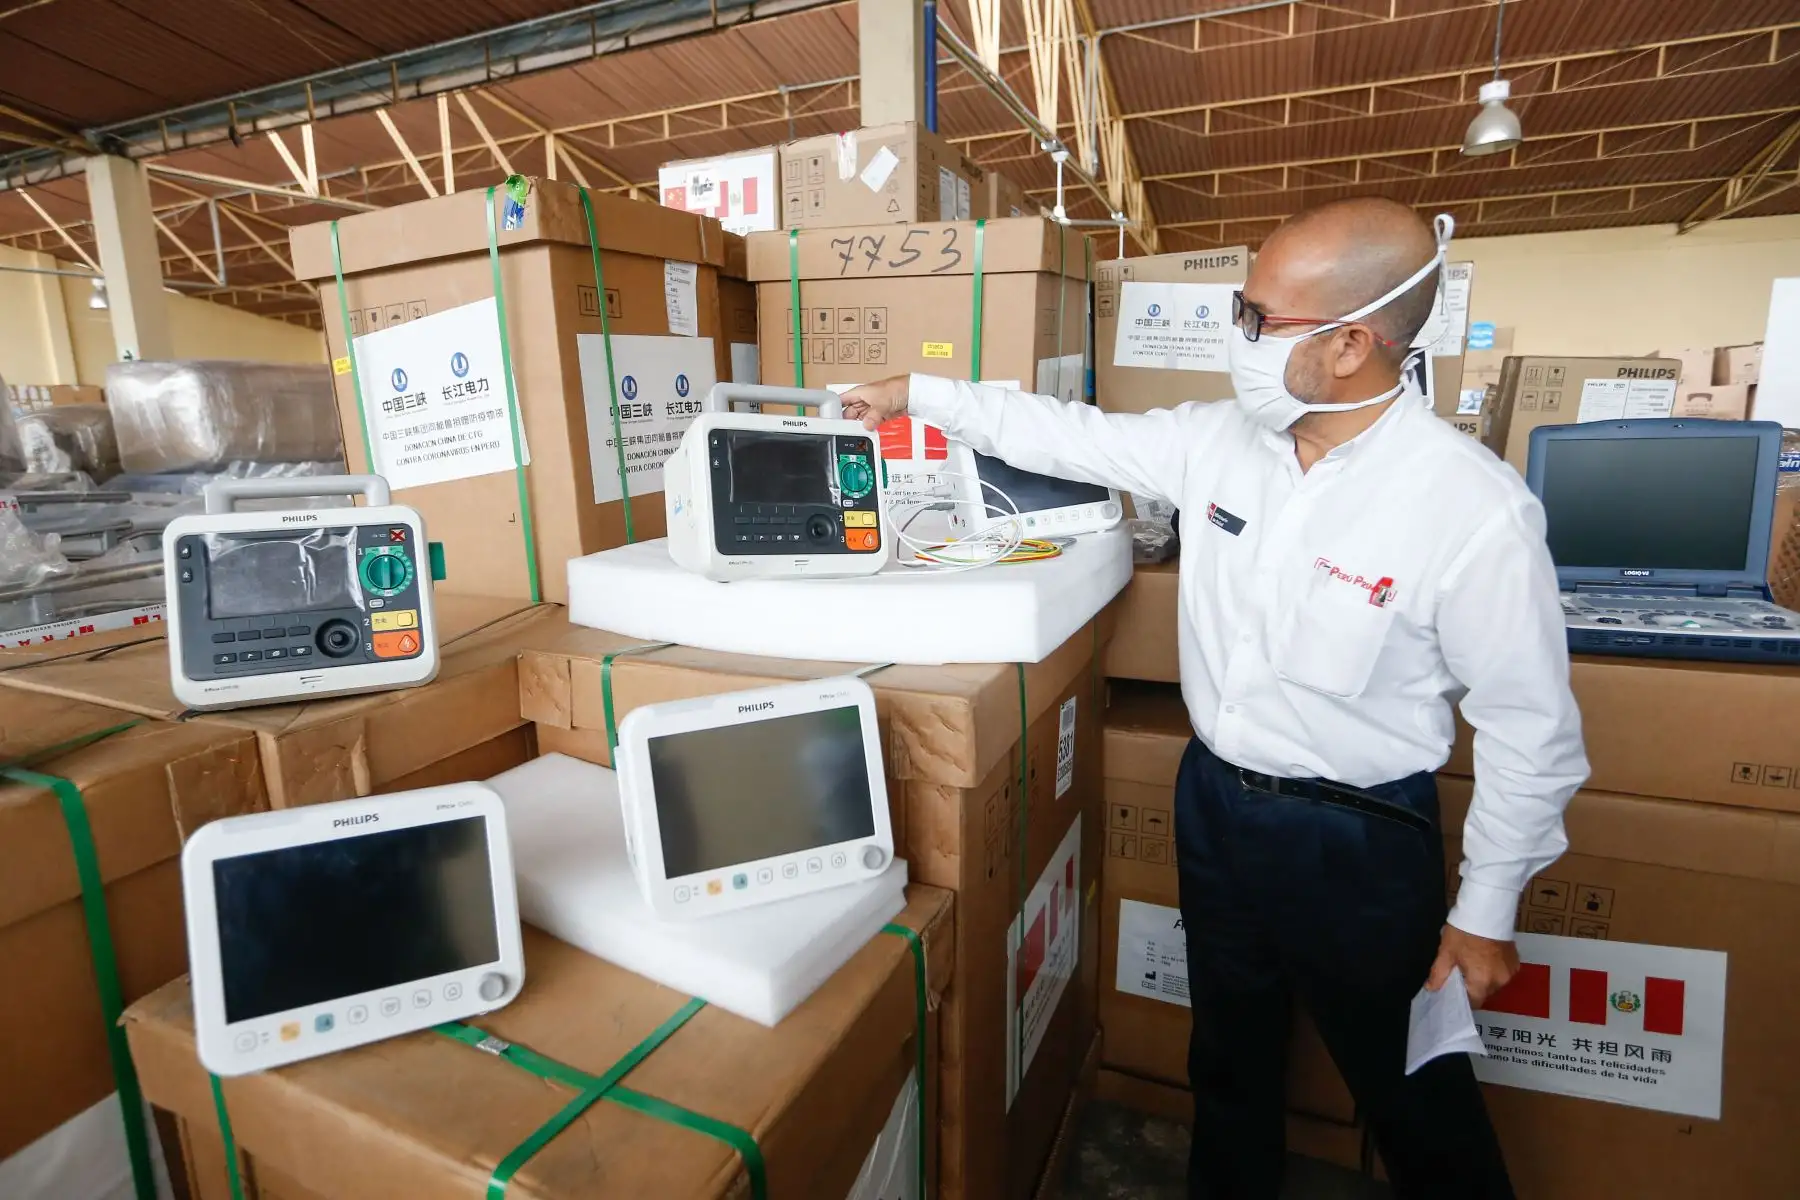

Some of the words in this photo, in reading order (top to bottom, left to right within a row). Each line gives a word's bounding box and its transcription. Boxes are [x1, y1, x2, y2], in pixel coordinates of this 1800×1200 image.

[831, 228, 961, 275] 7753
[1184, 255, 1239, 271] PHILIPS
[1135, 318, 1171, 327] 中国三峡
[1183, 320, 1220, 330] 长江电力
[1617, 367, 1677, 379] PHILIPS
[382, 392, 428, 413] 中国三峡
[442, 378, 489, 401] 长江电力
[665, 400, 703, 415] 长江电力
[783, 420, 808, 428] PHILIPS
[617, 463, 643, 476] CNTRA
[282, 514, 318, 523] PHILIPS
[363, 618, 370, 626] 2
[366, 642, 373, 651] 3
[738, 701, 775, 714] PHILIPS
[333, 813, 380, 828] PHILIPS
[1572, 1037, 1673, 1064] 共担风雨
[1512, 1055, 1528, 1065] las
[1531, 1059, 1597, 1076] dificultades
[1600, 1069, 1615, 1078] de
[1618, 1072, 1629, 1081] la
[1632, 1074, 1658, 1086] vida
[1548, 1051, 1577, 1062] tanto
[1580, 1056, 1597, 1066] las
[1601, 1059, 1667, 1076] felicidades
